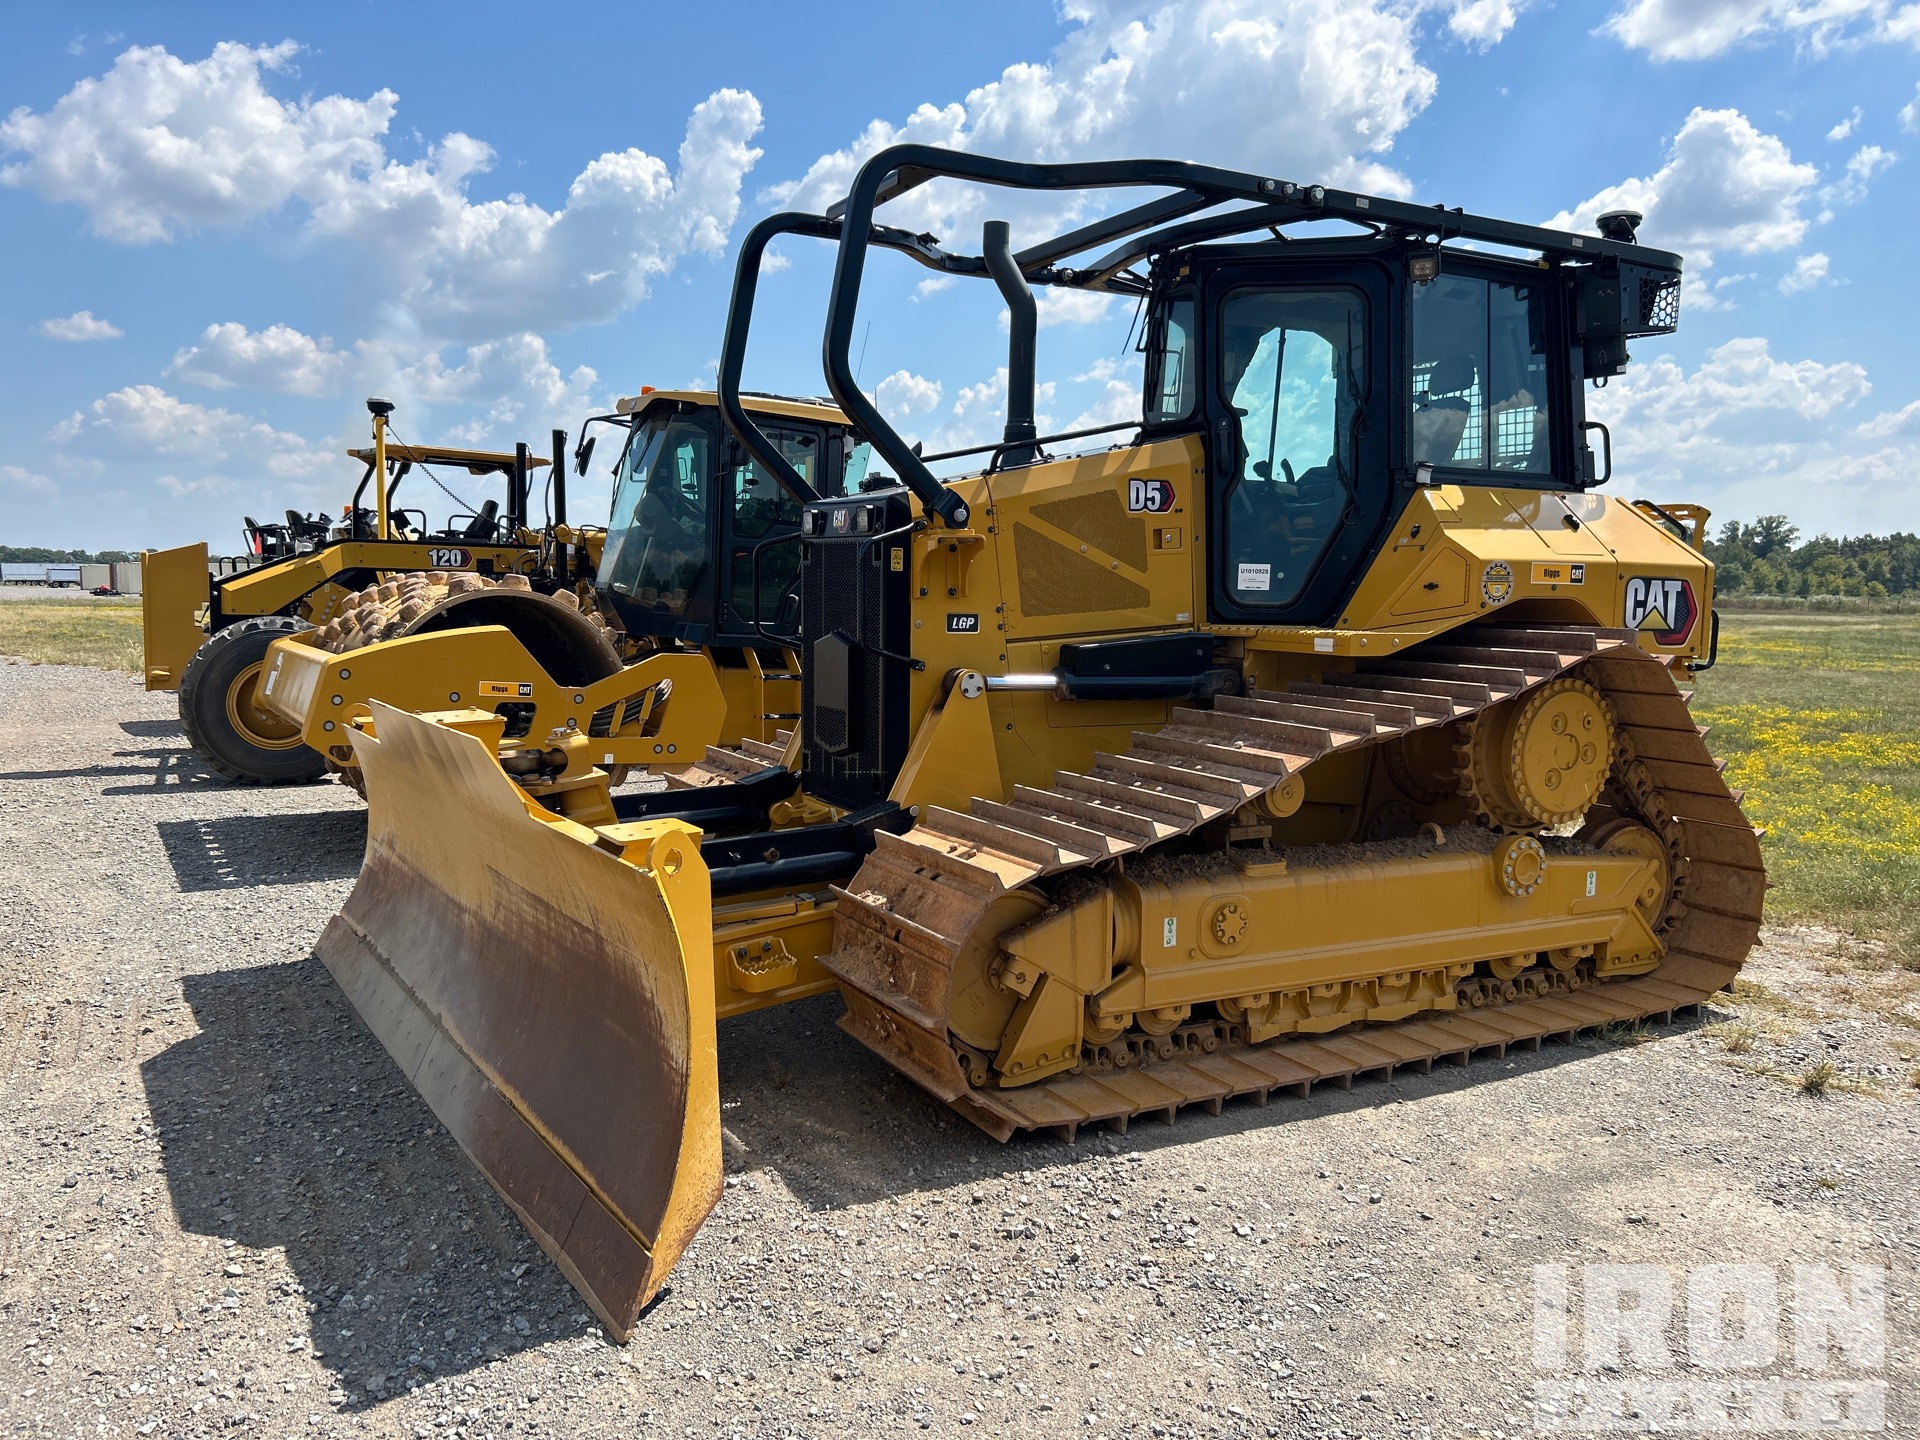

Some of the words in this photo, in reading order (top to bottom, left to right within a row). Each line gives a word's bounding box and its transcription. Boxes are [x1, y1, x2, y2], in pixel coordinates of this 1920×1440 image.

[1129, 480, 1161, 510] D5
[833, 510, 846, 527] CAT
[428, 549, 462, 567] 120
[1543, 568, 1561, 579] Riggs
[1571, 569, 1583, 579] CAT
[1625, 578, 1682, 630] CAT
[951, 616, 975, 629] LGP
[491, 685, 509, 693] Riggs
[519, 686, 531, 694] CAT
